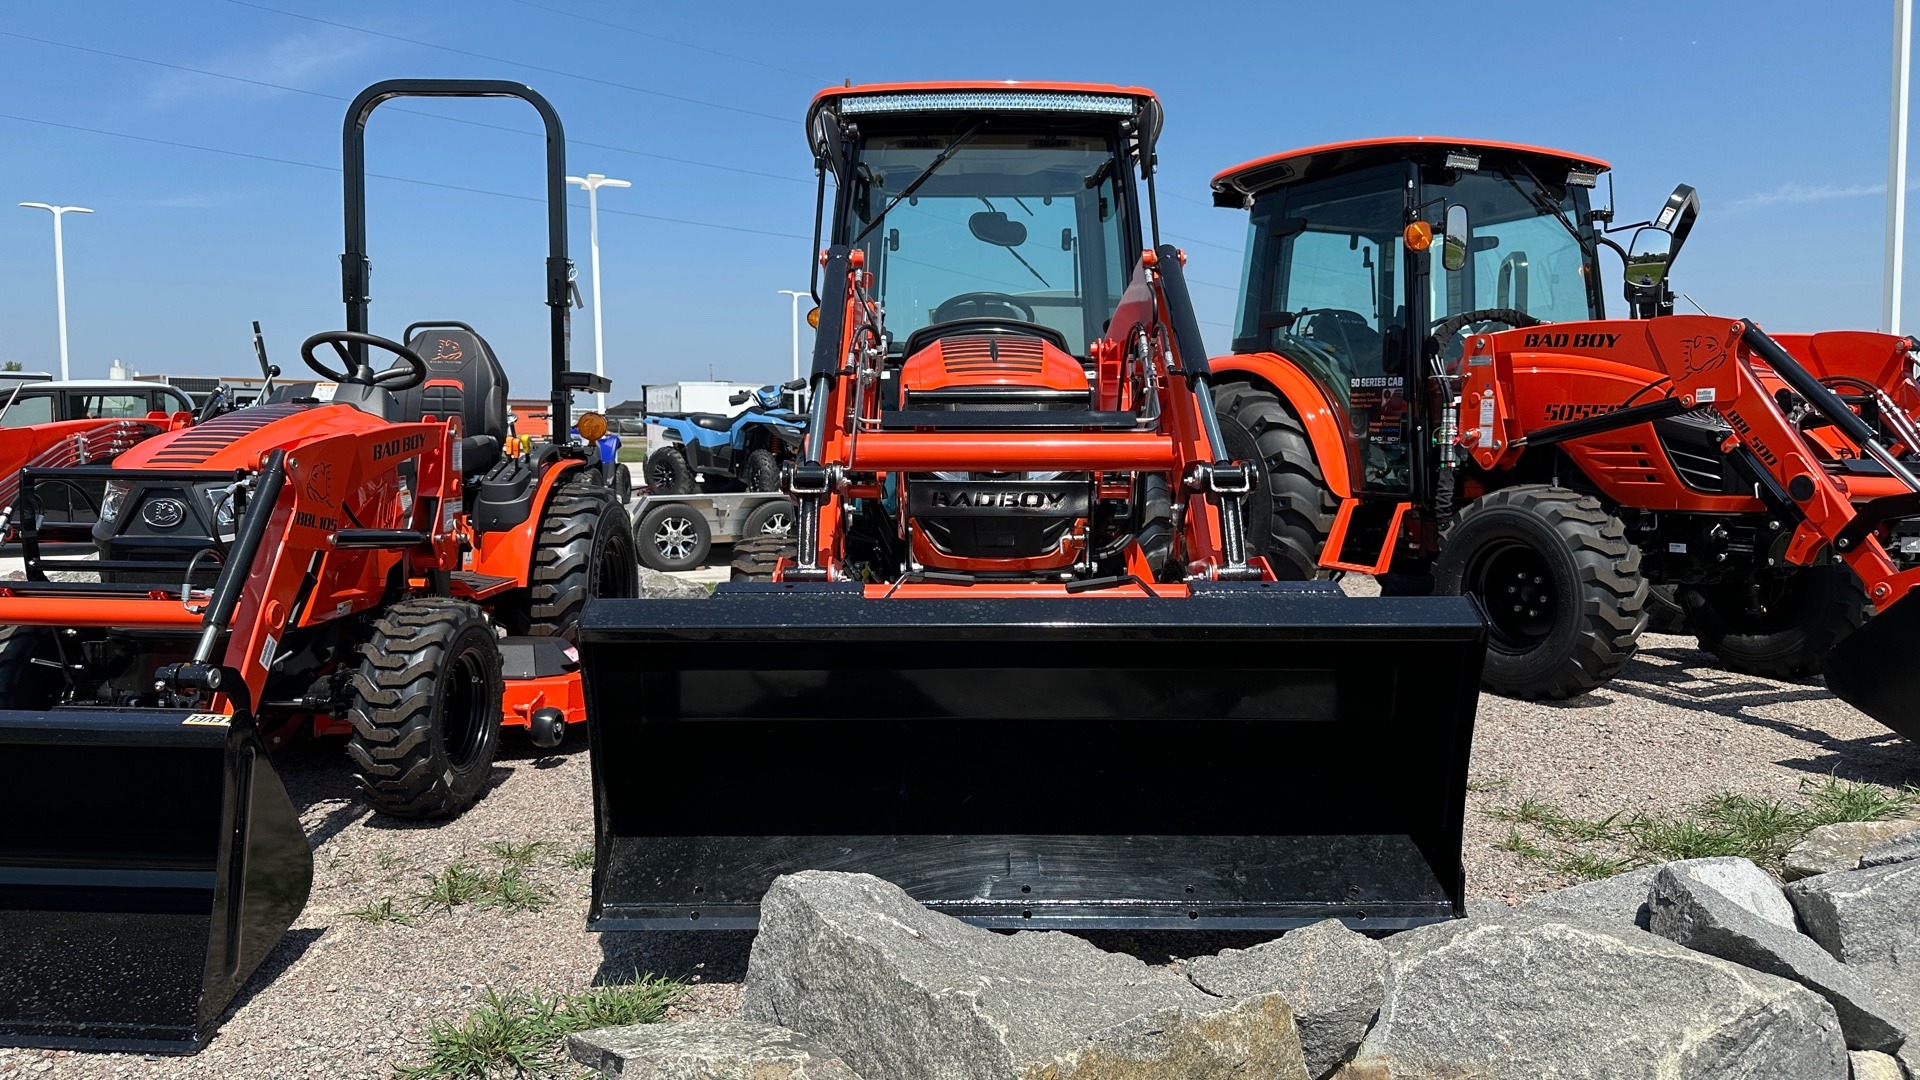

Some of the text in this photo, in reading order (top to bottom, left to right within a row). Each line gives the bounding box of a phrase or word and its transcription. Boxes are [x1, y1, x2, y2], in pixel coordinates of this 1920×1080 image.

[1523, 333, 1622, 348] BAD BOY
[1351, 377, 1403, 387] 50 SERIES CAB
[373, 432, 427, 461] BAD BOY
[1726, 410, 1779, 467] BBL 500
[296, 511, 338, 532] BBL 105
